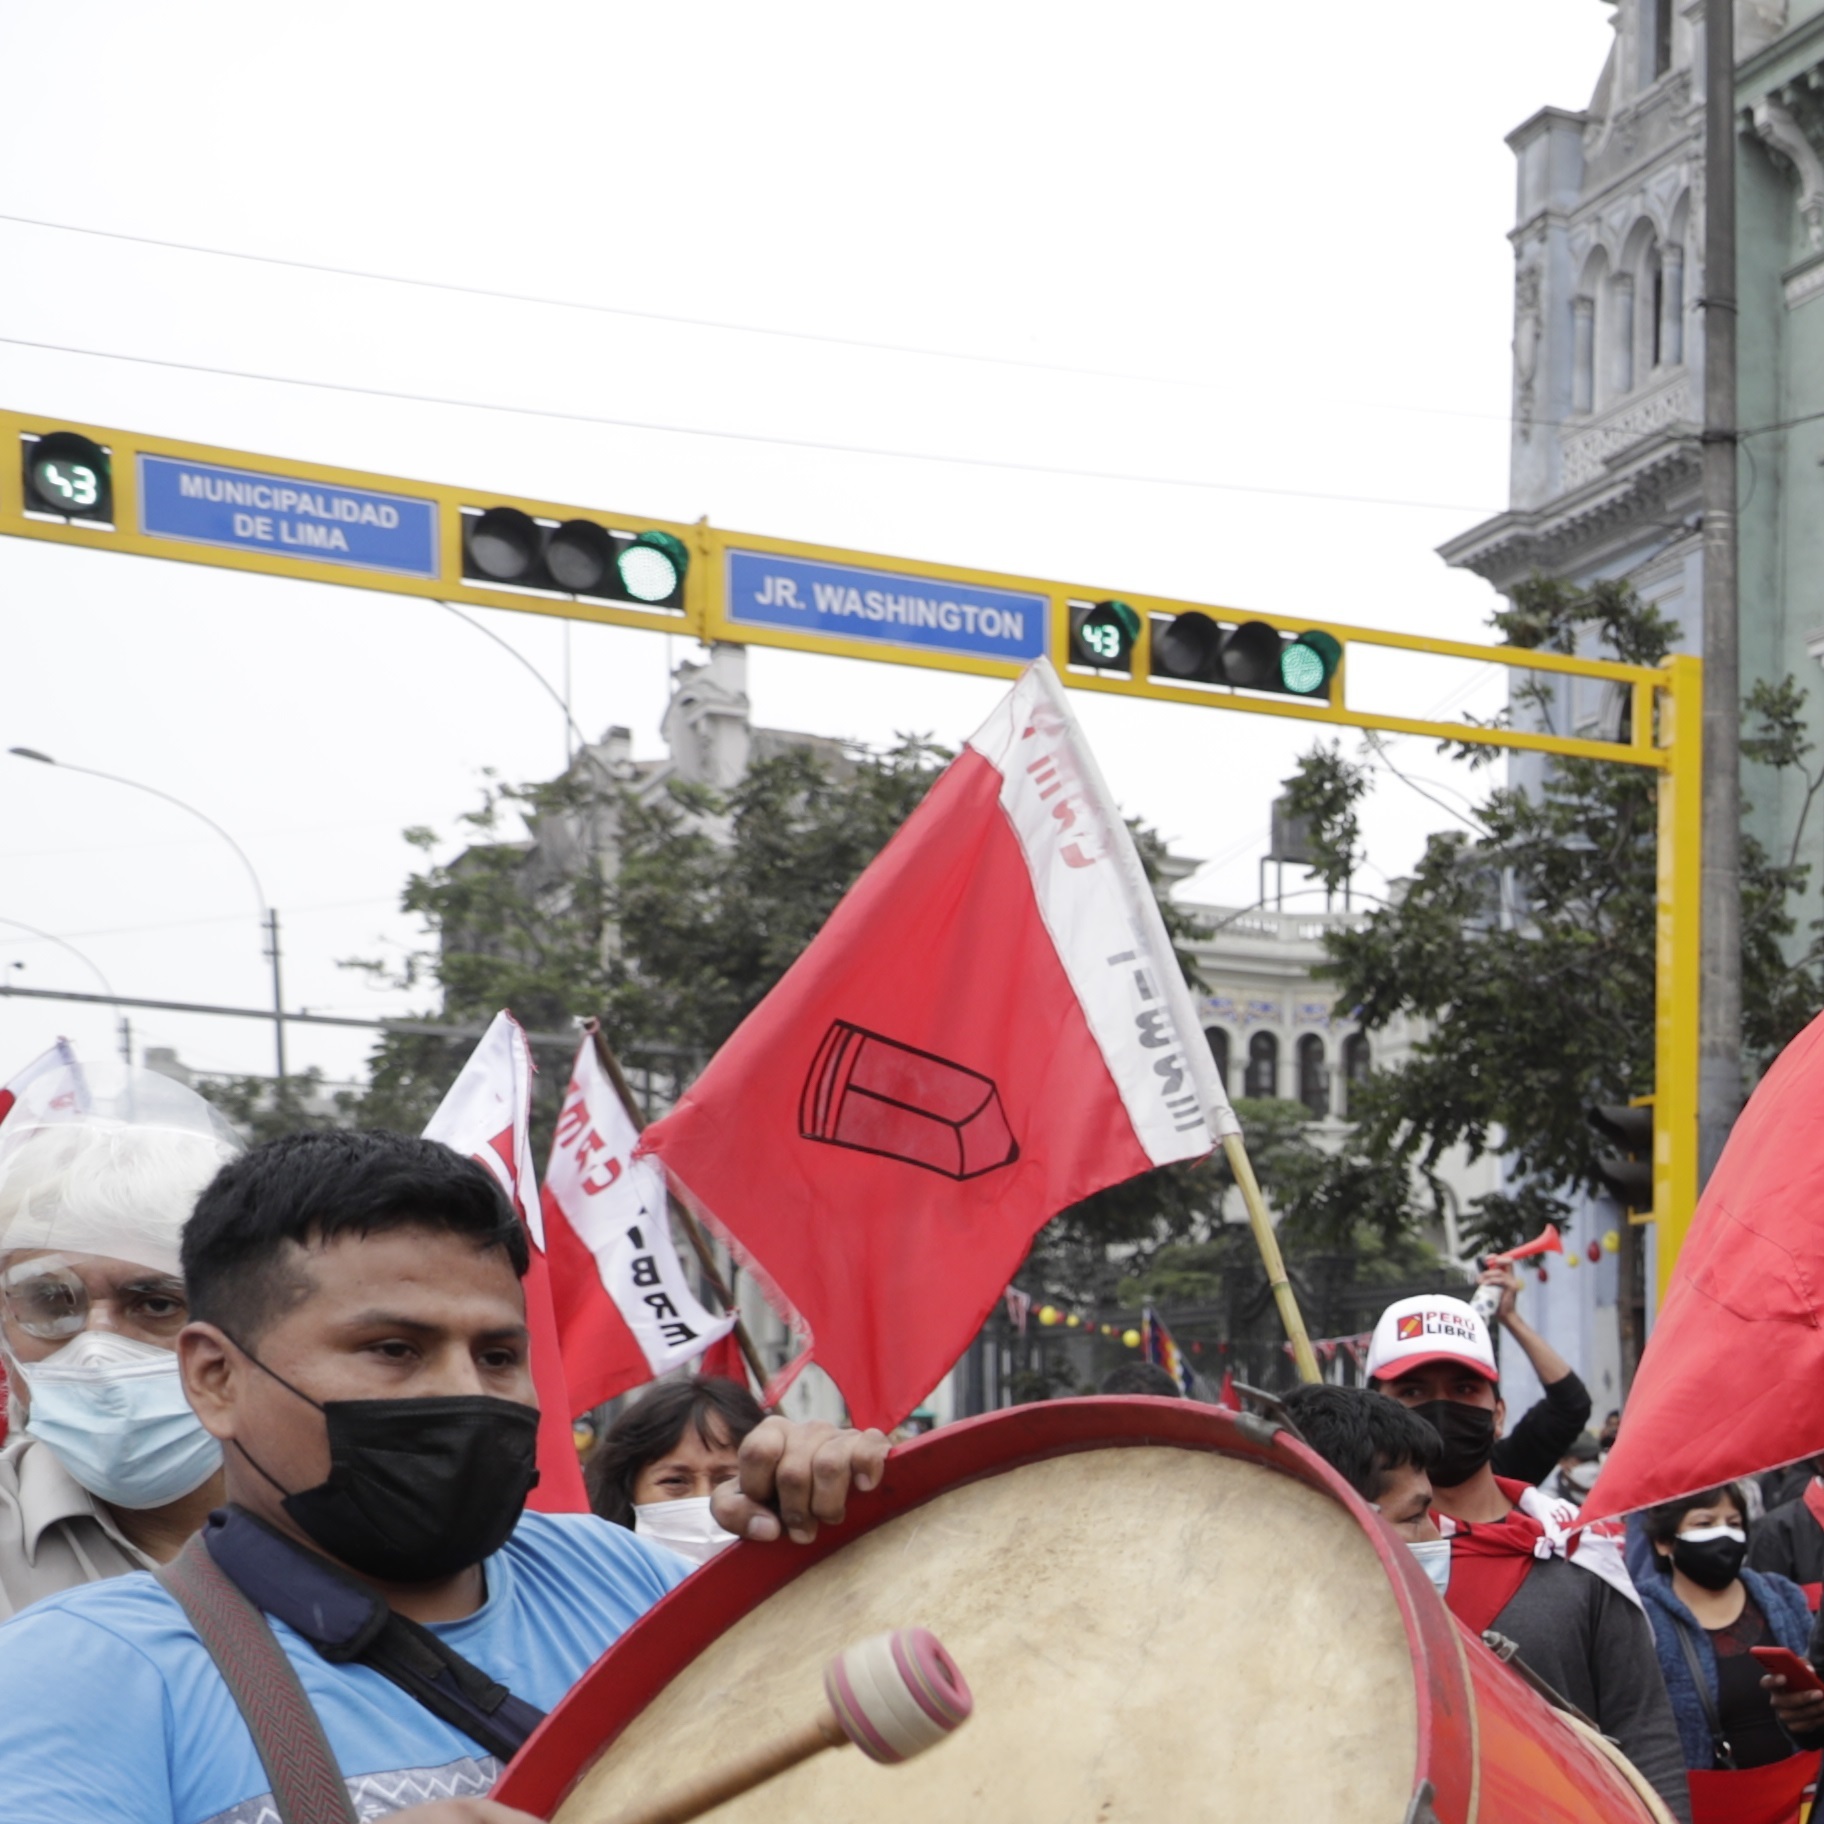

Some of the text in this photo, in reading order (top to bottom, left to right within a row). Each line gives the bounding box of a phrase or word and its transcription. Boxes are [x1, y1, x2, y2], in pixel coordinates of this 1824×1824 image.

[43, 463, 97, 505] 43
[180, 473, 399, 529] MUNICIPALIDAD
[234, 513, 350, 552] DE LIMA
[755, 575, 1024, 641] JR. WASHINGTON
[1082, 624, 1120, 658] 43
[1427, 1323, 1478, 1344] LIBRE
